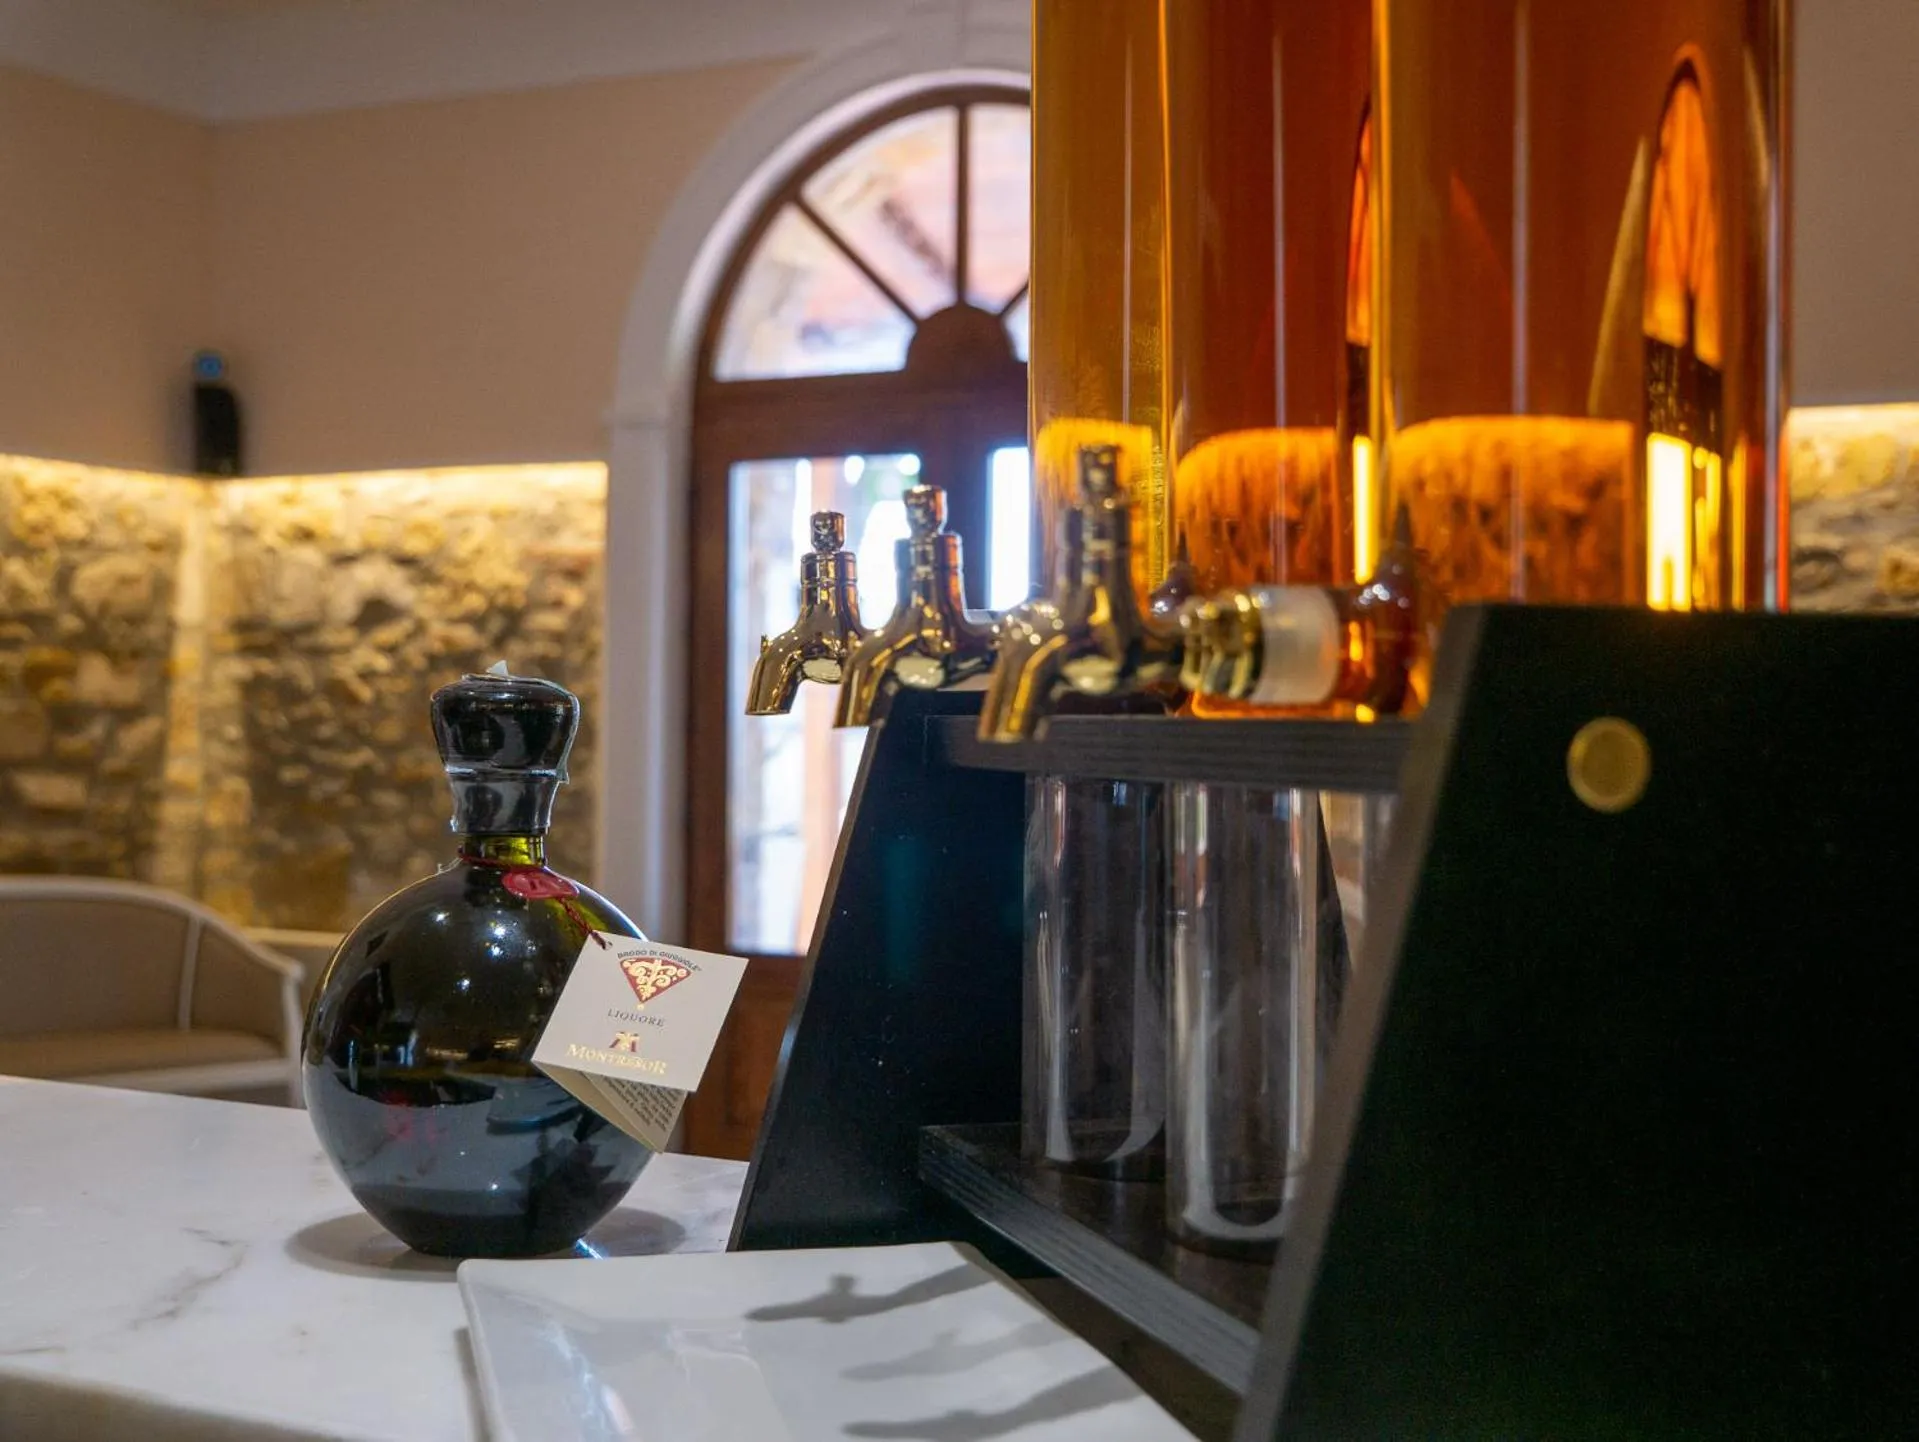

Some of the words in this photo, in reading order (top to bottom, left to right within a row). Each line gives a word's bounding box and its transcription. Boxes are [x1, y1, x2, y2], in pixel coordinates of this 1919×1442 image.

[617, 949, 647, 959] BRODO
[650, 949, 658, 957] DI
[607, 1008, 665, 1027] LIQUORE
